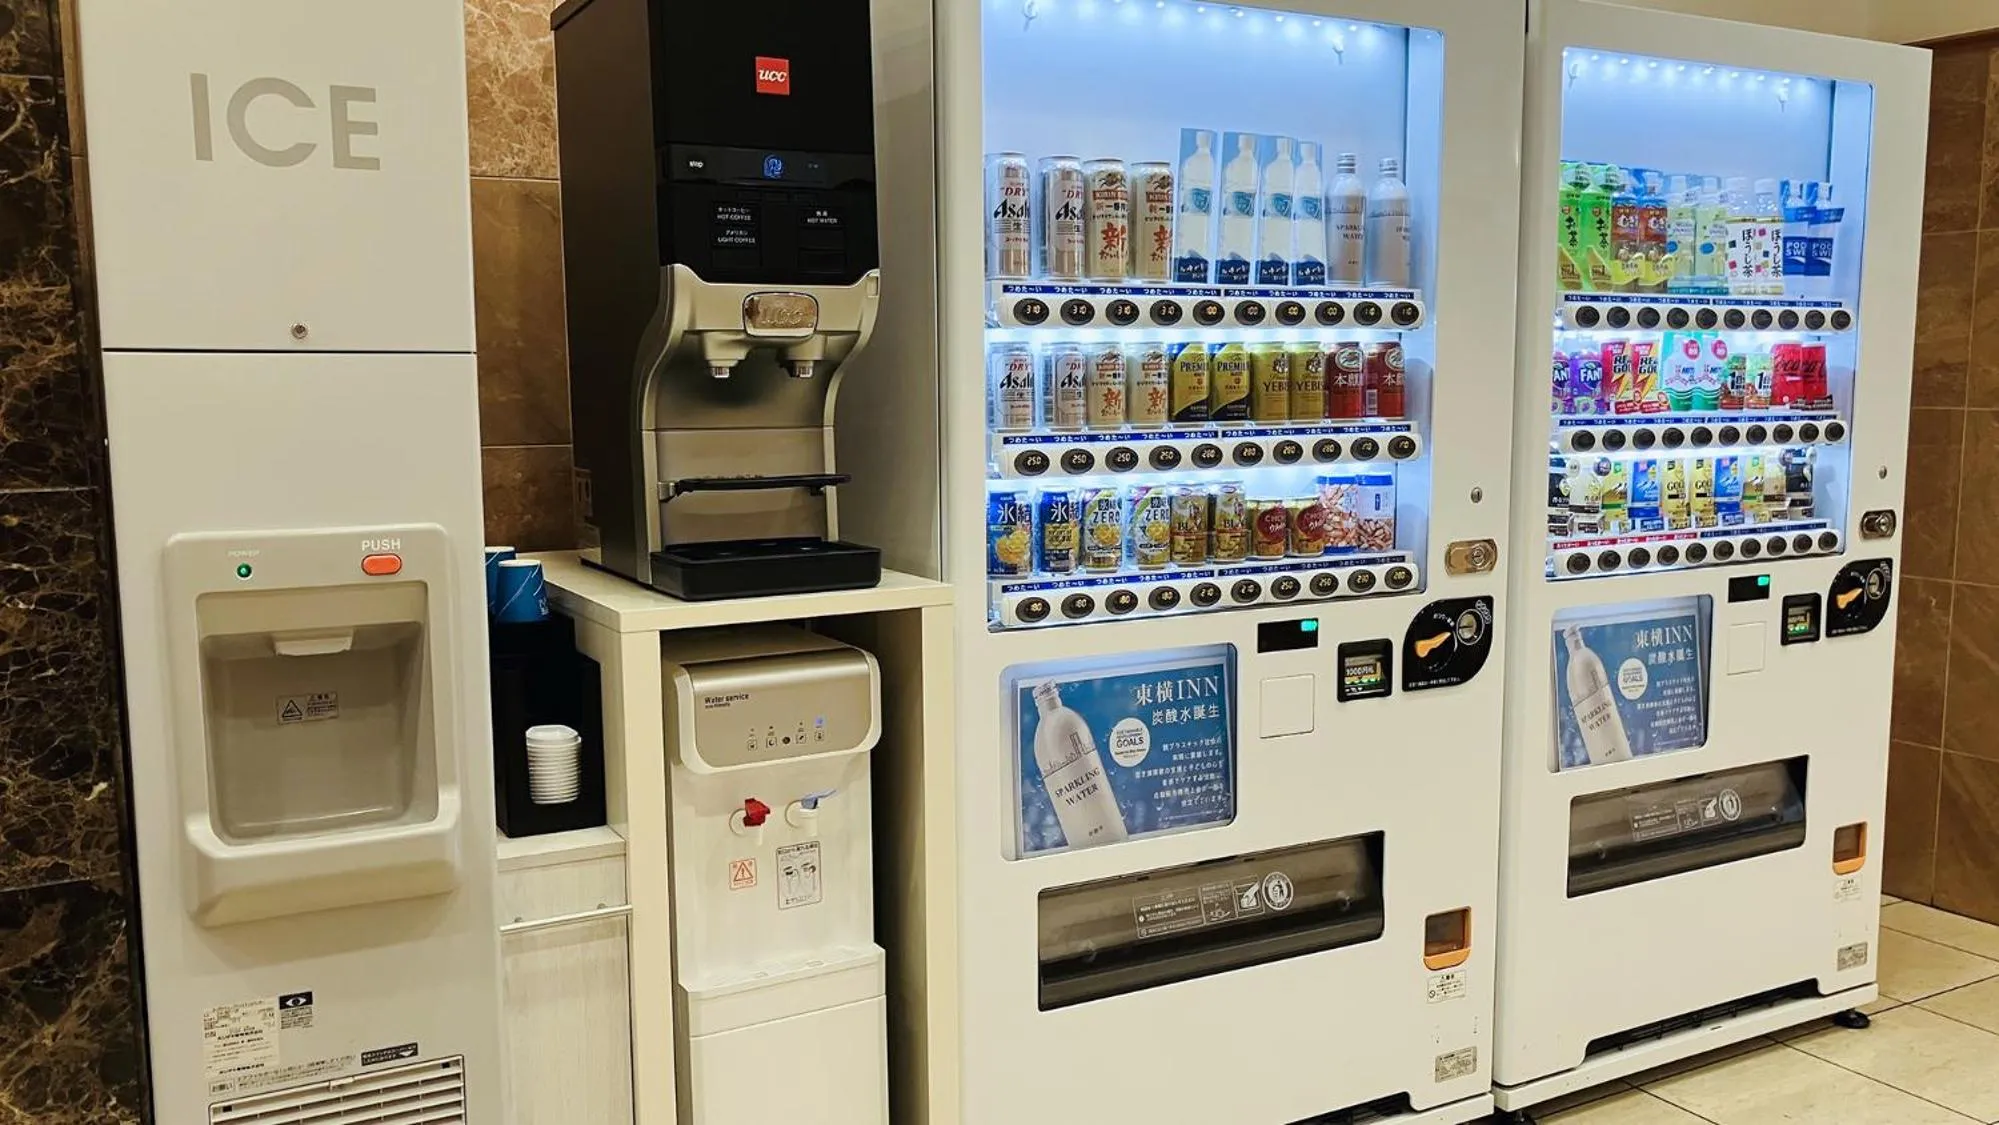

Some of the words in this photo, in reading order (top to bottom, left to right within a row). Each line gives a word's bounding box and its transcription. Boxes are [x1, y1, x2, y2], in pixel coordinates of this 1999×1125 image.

[190, 72, 381, 171] ICE
[1742, 228, 1754, 278] ほうじ茶
[1092, 511, 1121, 524] ZERO
[361, 539, 401, 551] PUSH
[1636, 625, 1693, 648] 東横INN
[1134, 675, 1219, 706] 東横INN
[1152, 704, 1220, 726] 炭酸水誕生
[1116, 737, 1144, 748] GOALS
[1055, 768, 1101, 798] SPARKLING
[1065, 783, 1099, 806] WATER
